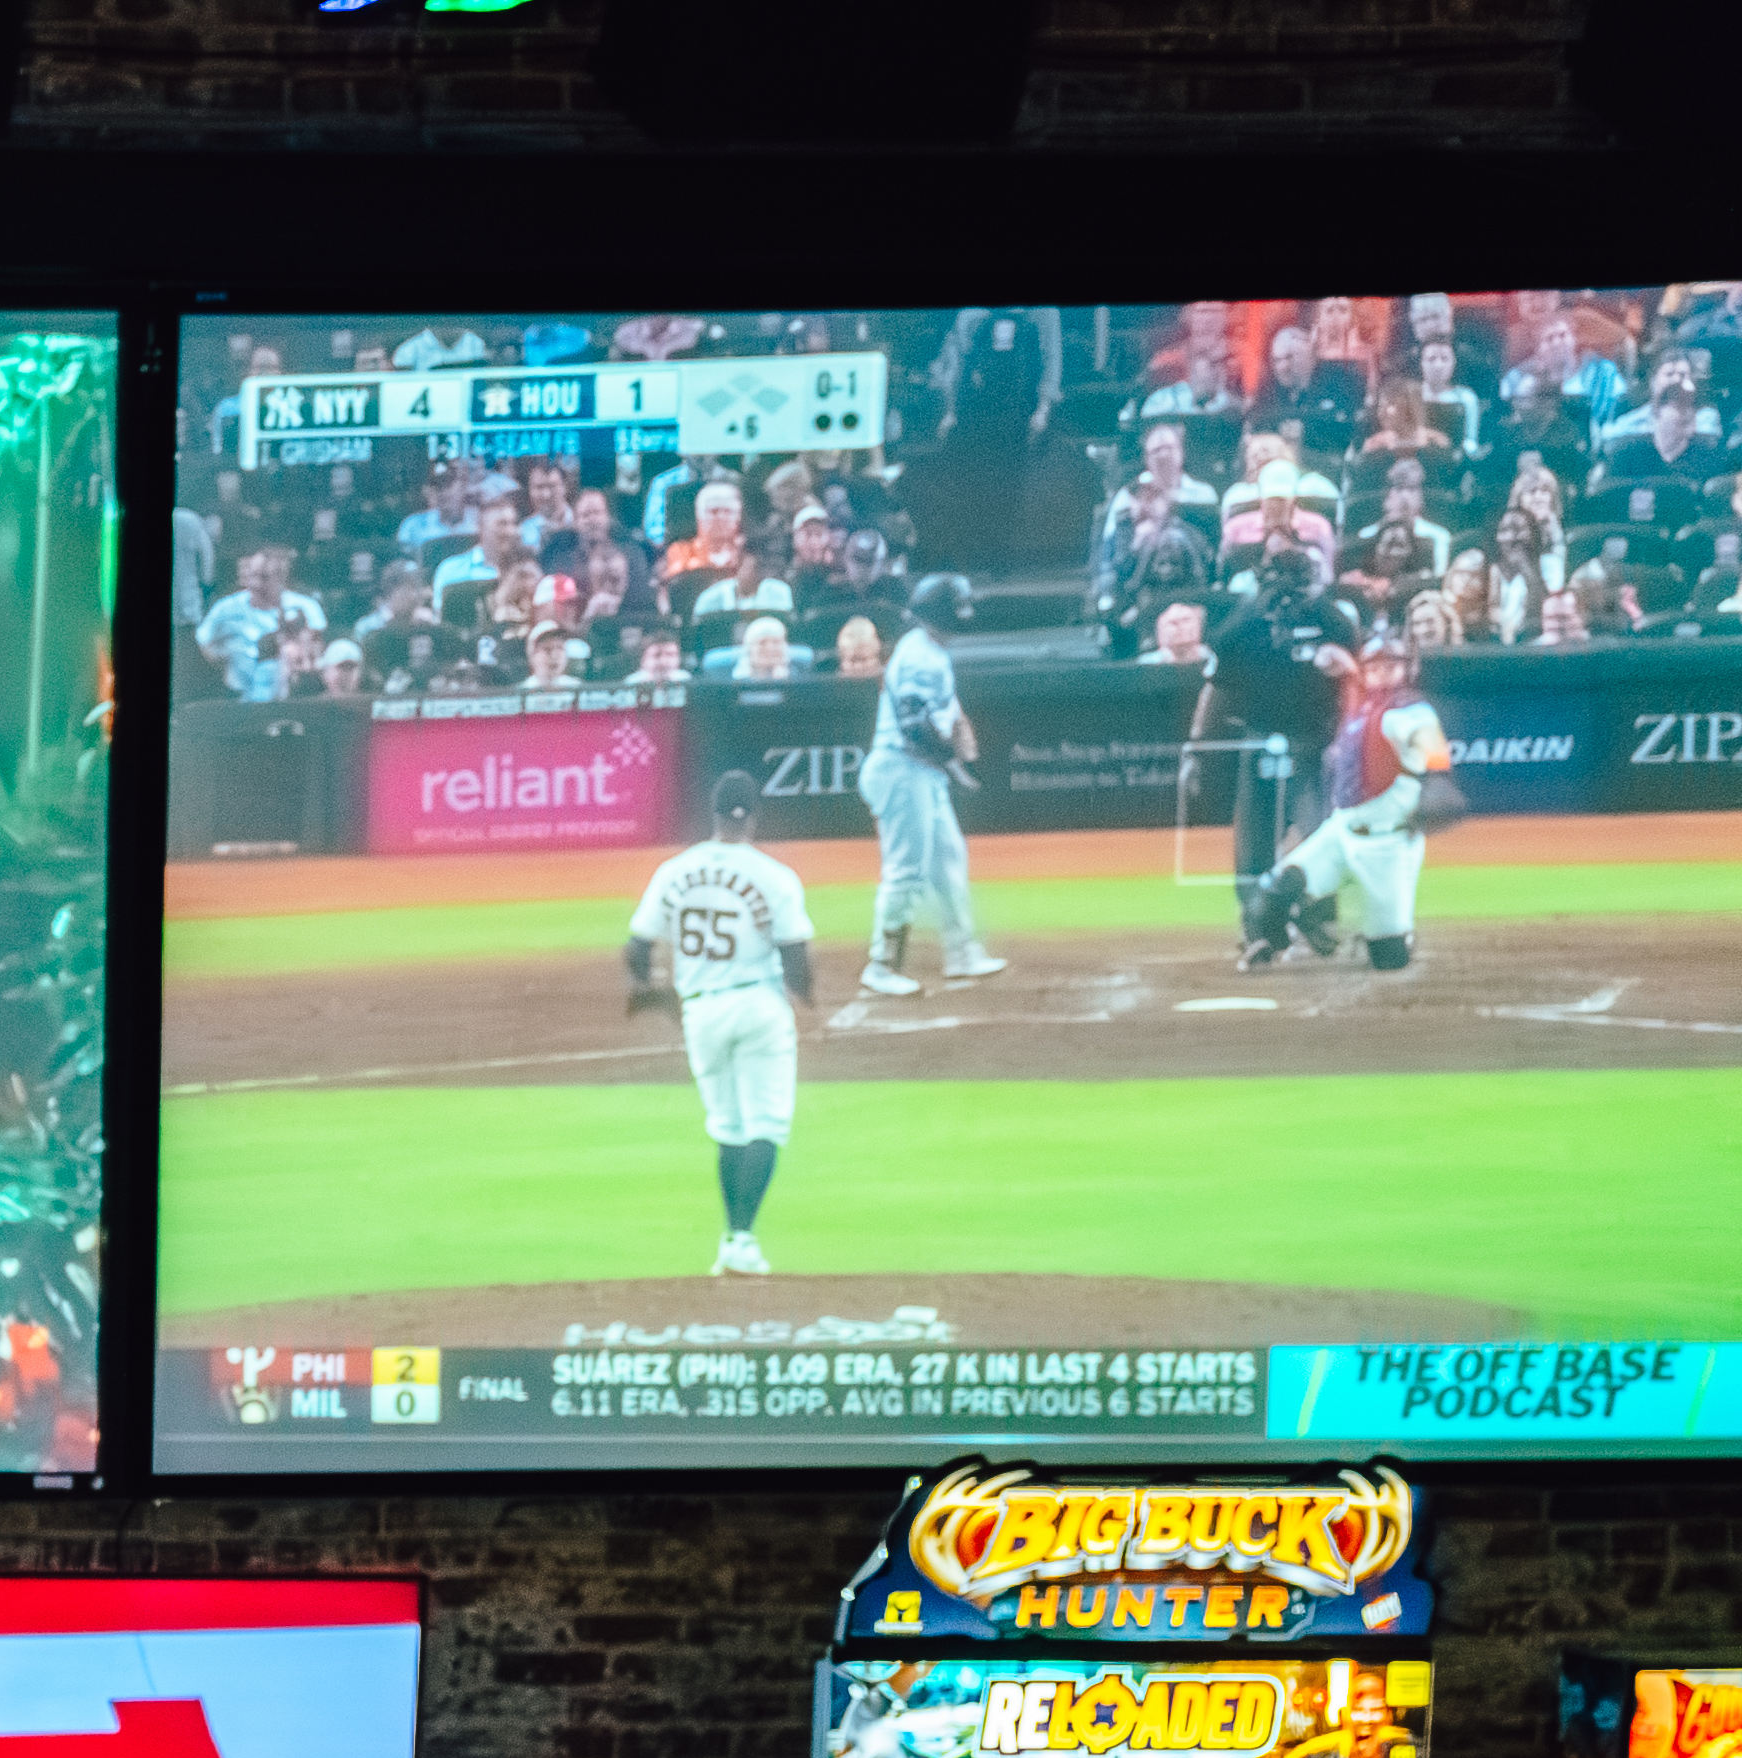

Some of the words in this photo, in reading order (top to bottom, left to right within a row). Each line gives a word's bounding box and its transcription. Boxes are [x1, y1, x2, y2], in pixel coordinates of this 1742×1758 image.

[313, 388, 370, 425] NYY
[408, 386, 431, 419] 4
[520, 380, 581, 417] HOU
[629, 378, 642, 413] 1
[1449, 735, 1574, 765] DAIKIN
[1630, 712, 1742, 764] ZIP
[420, 752, 618, 813] reliant
[680, 907, 740, 961] 65
[291, 1353, 346, 1383] PHI
[395, 1355, 416, 1384] 2
[552, 1349, 673, 1385] SUÁREZ
[764, 1353, 829, 1385] 1.09
[910, 1352, 951, 1385] 27
[956, 1352, 981, 1384] K
[986, 1352, 1020, 1384] IN
[1026, 1352, 1104, 1384] LAST
[1106, 1352, 1130, 1384] 4
[1135, 1352, 1257, 1385] STARTS
[1356, 1348, 1444, 1384] THE
[1453, 1347, 1546, 1384] OFF
[1553, 1346, 1683, 1384] BASE
[291, 1388, 348, 1419] MIL
[395, 1391, 415, 1418] 0
[457, 1375, 529, 1402] FINAL
[551, 1388, 613, 1417] 6.11
[841, 1388, 905, 1416] AVG
[911, 1388, 944, 1416] IN
[950, 1388, 1102, 1417] PREVIOUS
[1107, 1388, 1132, 1417] 6
[1137, 1388, 1256, 1417] STARTS
[1400, 1383, 1628, 1420] PODCAST
[970, 1487, 1135, 1580] BIG
[1136, 1487, 1355, 1592] BUCK
[1014, 1584, 1292, 1630] HUNTER
[981, 1673, 1280, 1755] RELOADED
